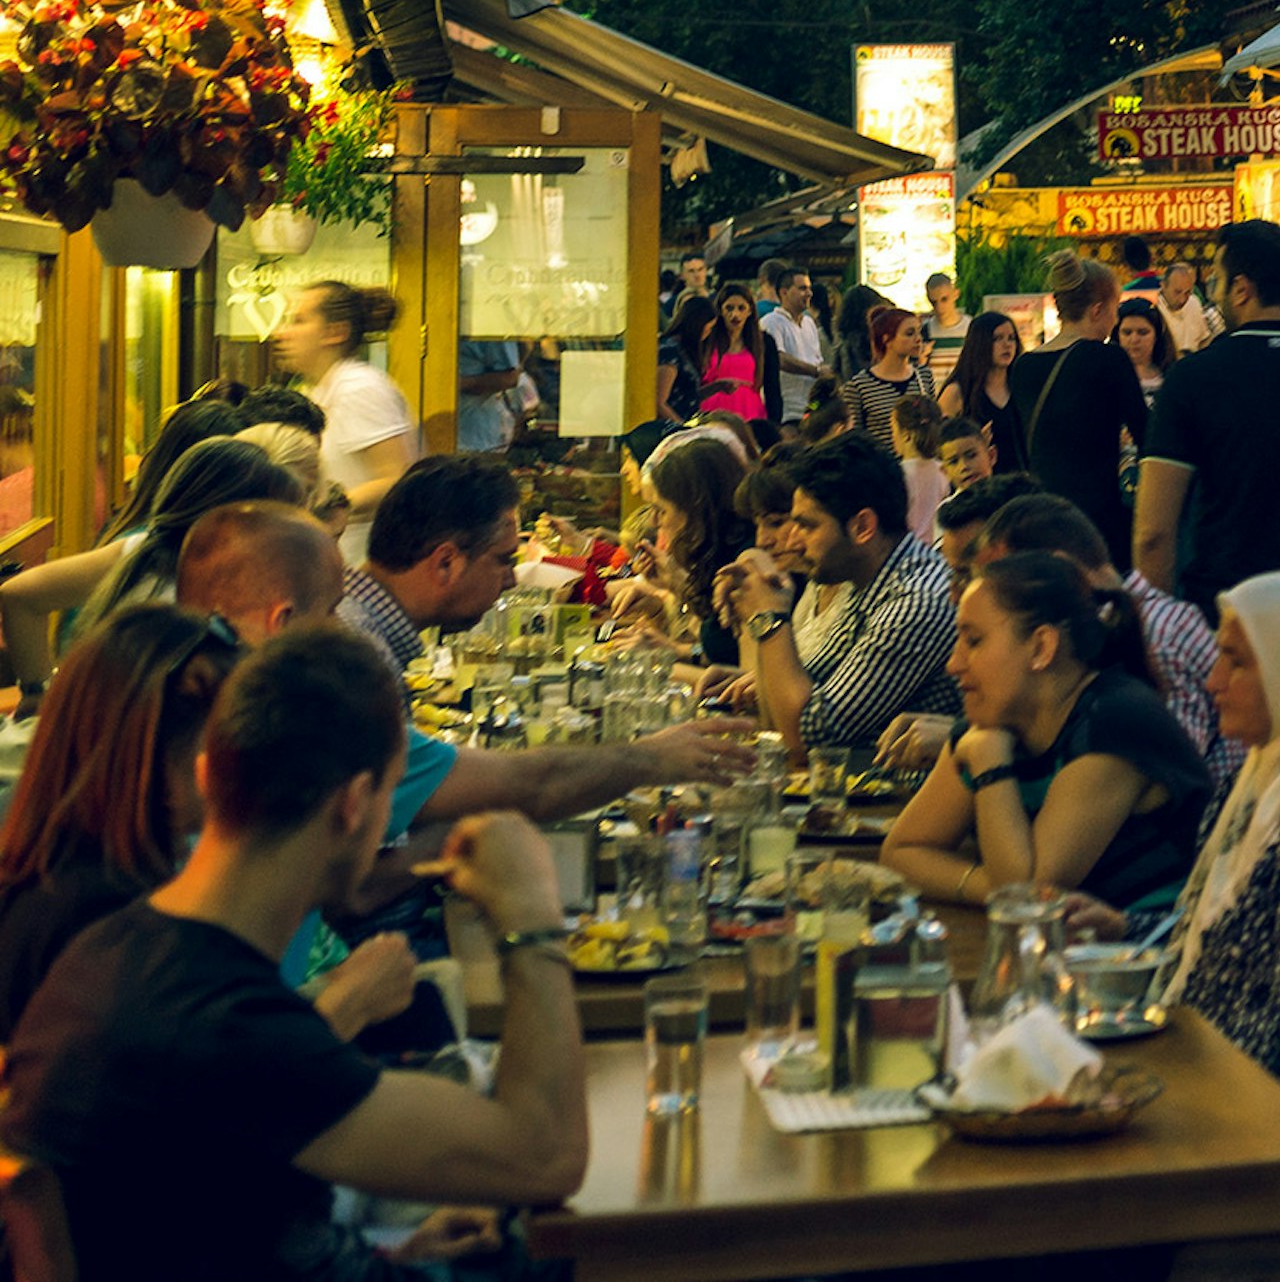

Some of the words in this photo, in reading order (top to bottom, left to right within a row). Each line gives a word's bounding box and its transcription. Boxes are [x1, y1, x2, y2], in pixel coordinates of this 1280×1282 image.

[1106, 113, 1230, 129] BOSANSKA
[1142, 126, 1217, 156] STEAK
[1096, 204, 1161, 232] STEAK
[1164, 202, 1232, 229] HOUSE
